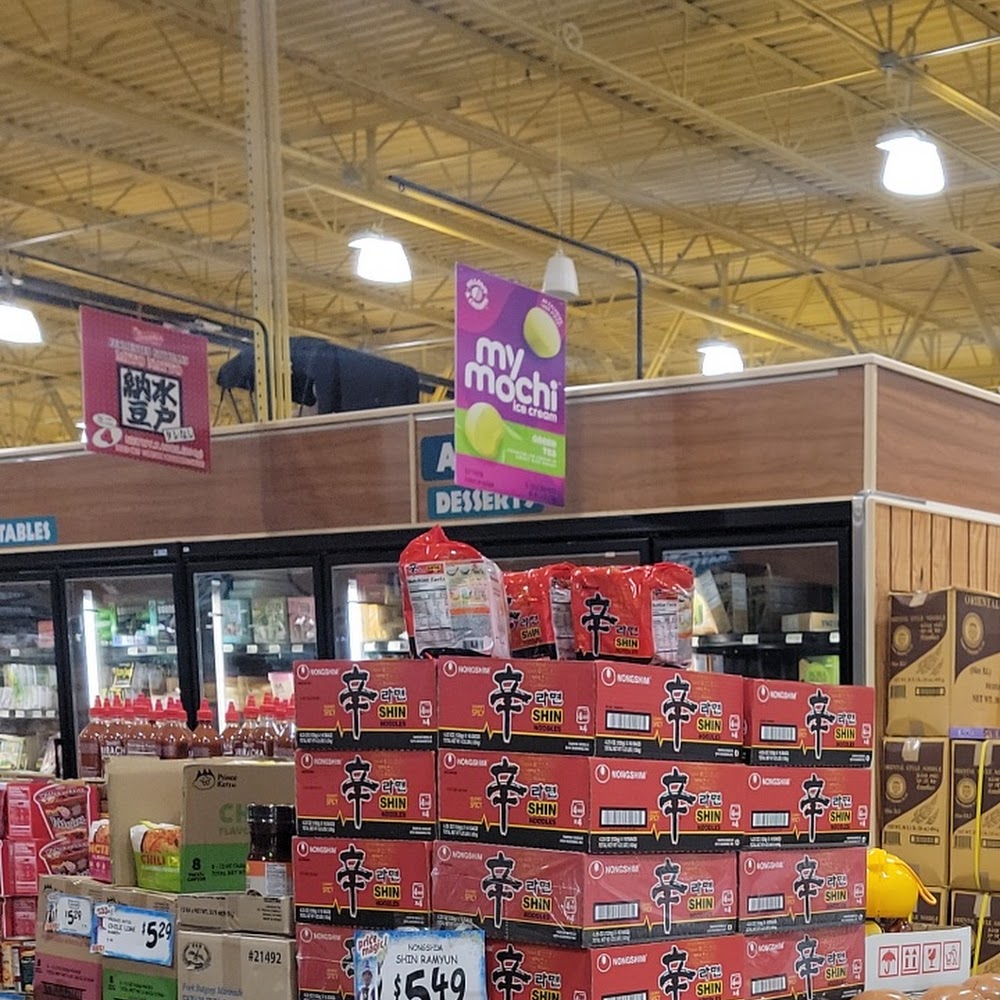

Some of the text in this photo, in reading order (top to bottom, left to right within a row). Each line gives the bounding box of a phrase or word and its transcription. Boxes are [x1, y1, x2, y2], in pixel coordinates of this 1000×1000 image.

[476, 337, 525, 381] my
[465, 362, 558, 412] mochi
[513, 399, 557, 423] ice cream
[965, 596, 1000, 610] ORIENTAL
[582, 593, 618, 656] 辛
[615, 624, 639, 637] 라면
[521, 627, 541, 641] SHIN
[615, 637, 639, 649] SHIN
[339, 664, 377, 740] 辛
[380, 687, 406, 702] 라면
[535, 690, 563, 705] 라면
[489, 663, 532, 743] 辛
[700, 701, 722, 715] 라면
[379, 705, 407, 720] SHIN
[531, 708, 563, 724] SHIN
[662, 673, 698, 752] 辛
[837, 713, 857, 725] 라면
[697, 718, 722, 732] SHIN
[805, 689, 836, 759] 辛
[835, 727, 856, 740] SHIN
[341, 755, 380, 829] 辛
[383, 780, 407, 793] 라면
[530, 784, 558, 798] 라면
[379, 796, 407, 810] SHIN
[487, 756, 528, 836] 辛
[699, 792, 722, 806] 라면
[527, 802, 557, 817] SHIN
[659, 766, 697, 844] 辛
[696, 809, 722, 824] SHIN
[192, 858, 201, 870] 8
[481, 851, 523, 928] 辛
[525, 880, 552, 895] 라면
[523, 897, 551, 911] SHIN
[142, 921, 172, 949] $529
[249, 950, 282, 965] #21492
[396, 954, 458, 965] SHIN RAMYUN
[698, 965, 722, 978] 라면
[696, 982, 722, 996] SHIN
